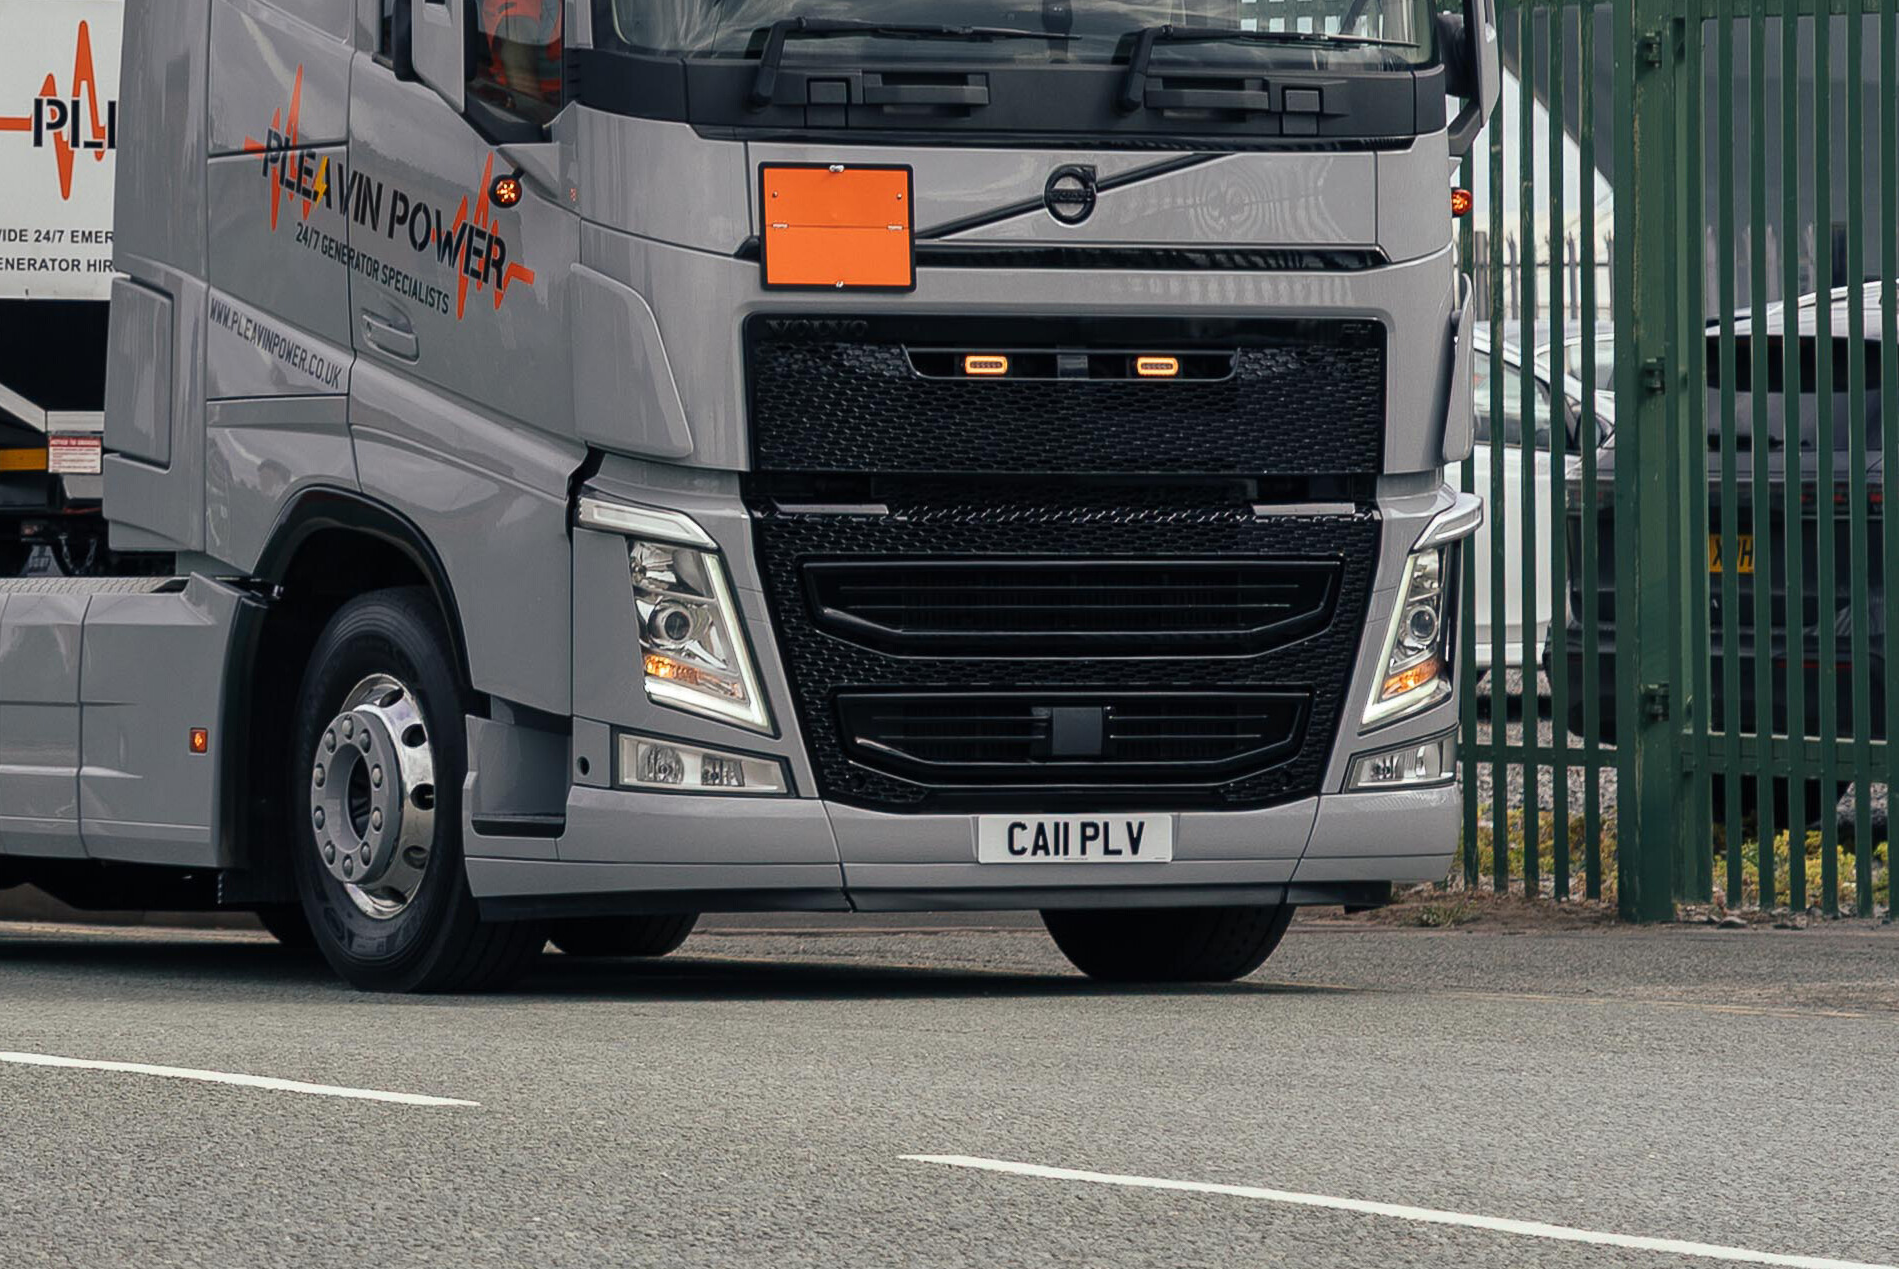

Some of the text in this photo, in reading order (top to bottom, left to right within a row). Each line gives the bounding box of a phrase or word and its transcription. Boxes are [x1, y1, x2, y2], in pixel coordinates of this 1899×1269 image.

[33, 228, 64, 244] 24/7
[262, 127, 507, 291] PLEAVIN POWER
[296, 222, 450, 315] 24/7 GENERATOR SPECIALISTS
[209, 297, 342, 390] WWW.PLEAVINPOWER.CO.UK
[1079, 820, 1146, 857] PLV
